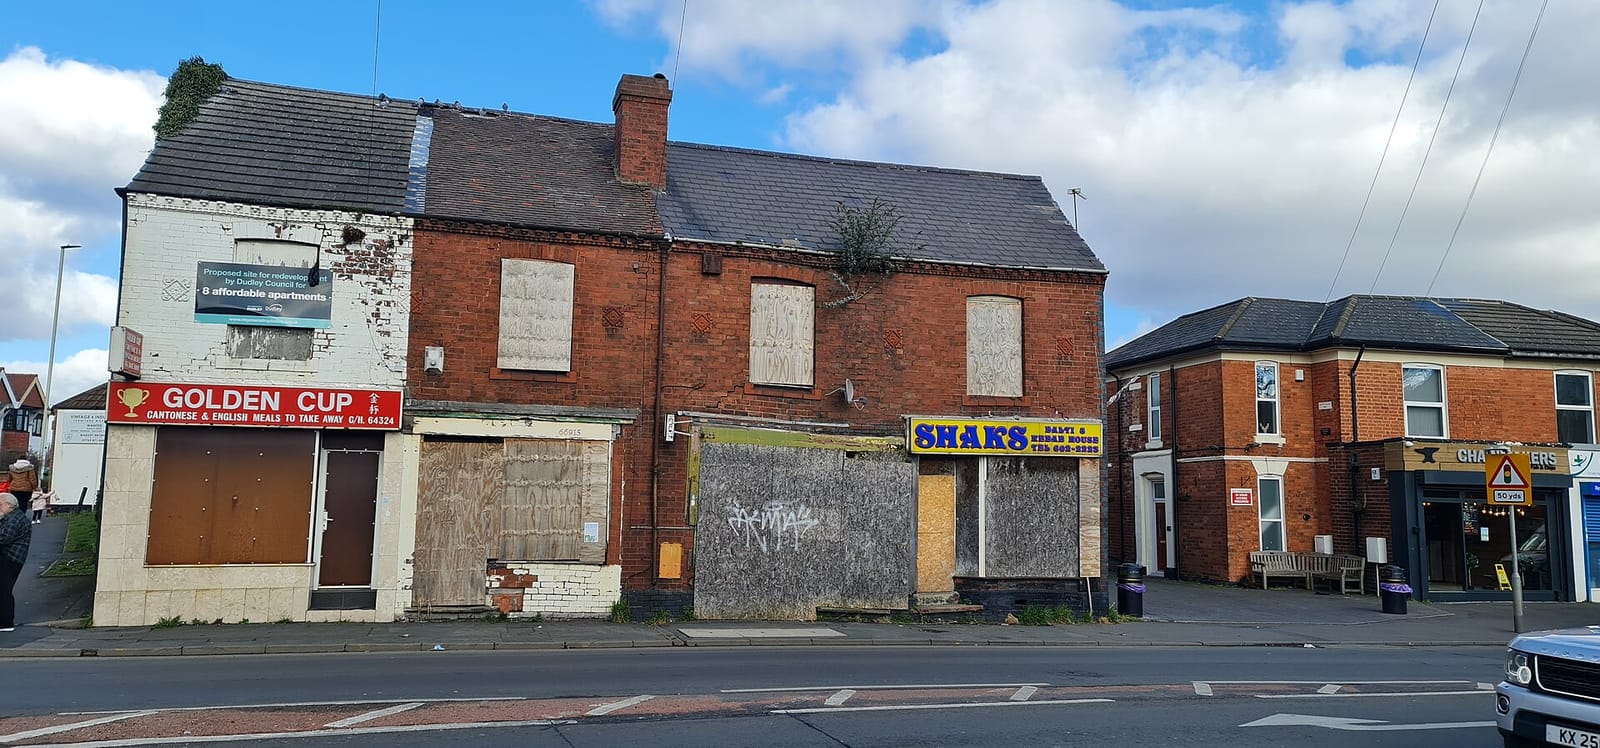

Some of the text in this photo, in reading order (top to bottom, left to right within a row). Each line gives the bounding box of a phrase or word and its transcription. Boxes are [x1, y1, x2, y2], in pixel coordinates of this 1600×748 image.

[203, 268, 328, 283] Proposed site for redevelopnt
[236, 278, 264, 287] Dudley
[265, 279, 294, 288] Council
[295, 280, 307, 289] for
[202, 287, 327, 302] 8 affordable apartments
[163, 387, 354, 413] GOLDEN CUP
[146, 410, 198, 421] CANTONESE
[201, 412, 209, 421] &
[212, 412, 248, 422] ENGLISH
[252, 413, 281, 423] MEALS
[285, 414, 296, 423] TO
[299, 414, 320, 423] TAKE
[322, 415, 344, 424] AWAY
[367, 416, 395, 425] 64324
[914, 423, 1029, 451] SHAKS
[1045, 425, 1075, 435] BALTI
[1031, 435, 1099, 445] KEBAB HOUSE
[1031, 443, 1051, 452] TEL
[1509, 492, 1522, 500] yds
[1559, 728, 1577, 746] KX
